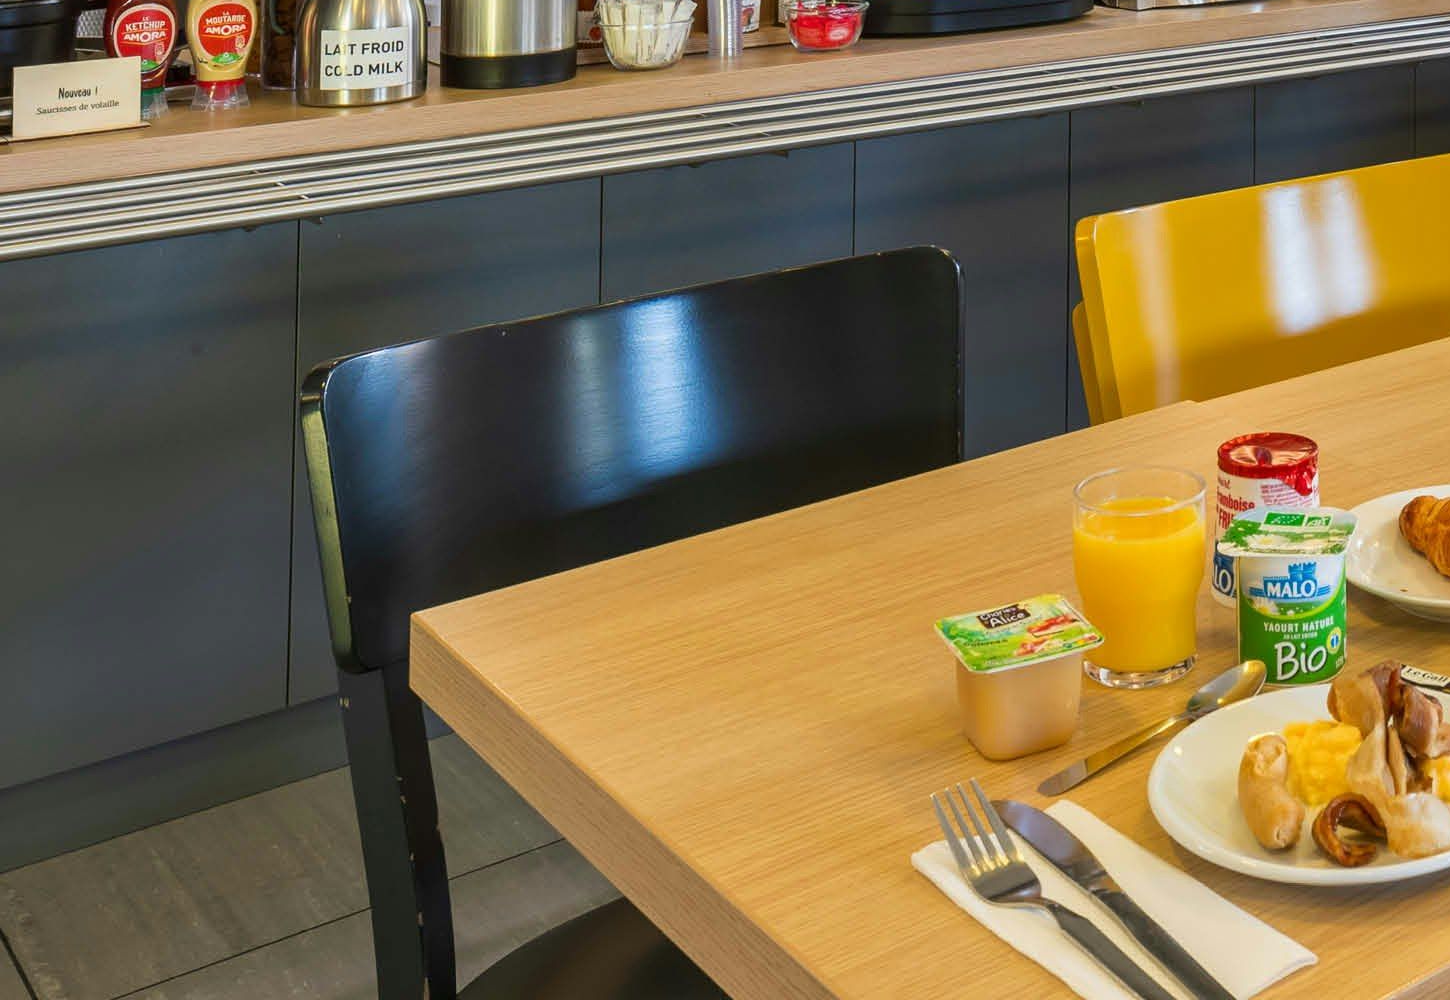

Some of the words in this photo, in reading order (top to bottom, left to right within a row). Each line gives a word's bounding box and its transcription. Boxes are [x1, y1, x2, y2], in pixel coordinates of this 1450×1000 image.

[125, 20, 166, 32] KETCHUP
[205, 14, 247, 25] MOUTARDE
[123, 30, 166, 43] AMORA
[204, 24, 247, 36] AMORA
[361, 40, 404, 55] FROID
[368, 60, 404, 75] MILK
[58, 87, 91, 100] Nouveau
[35, 104, 77, 115] Saucisses
[79, 103, 89, 111] de
[91, 100, 120, 110] volaille
[1266, 579, 1316, 599] MALO
[990, 612, 1025, 628] Alice
[1263, 621, 1299, 633] YAOURT
[1302, 615, 1335, 632] NATURE
[1274, 641, 1327, 681] Bio
